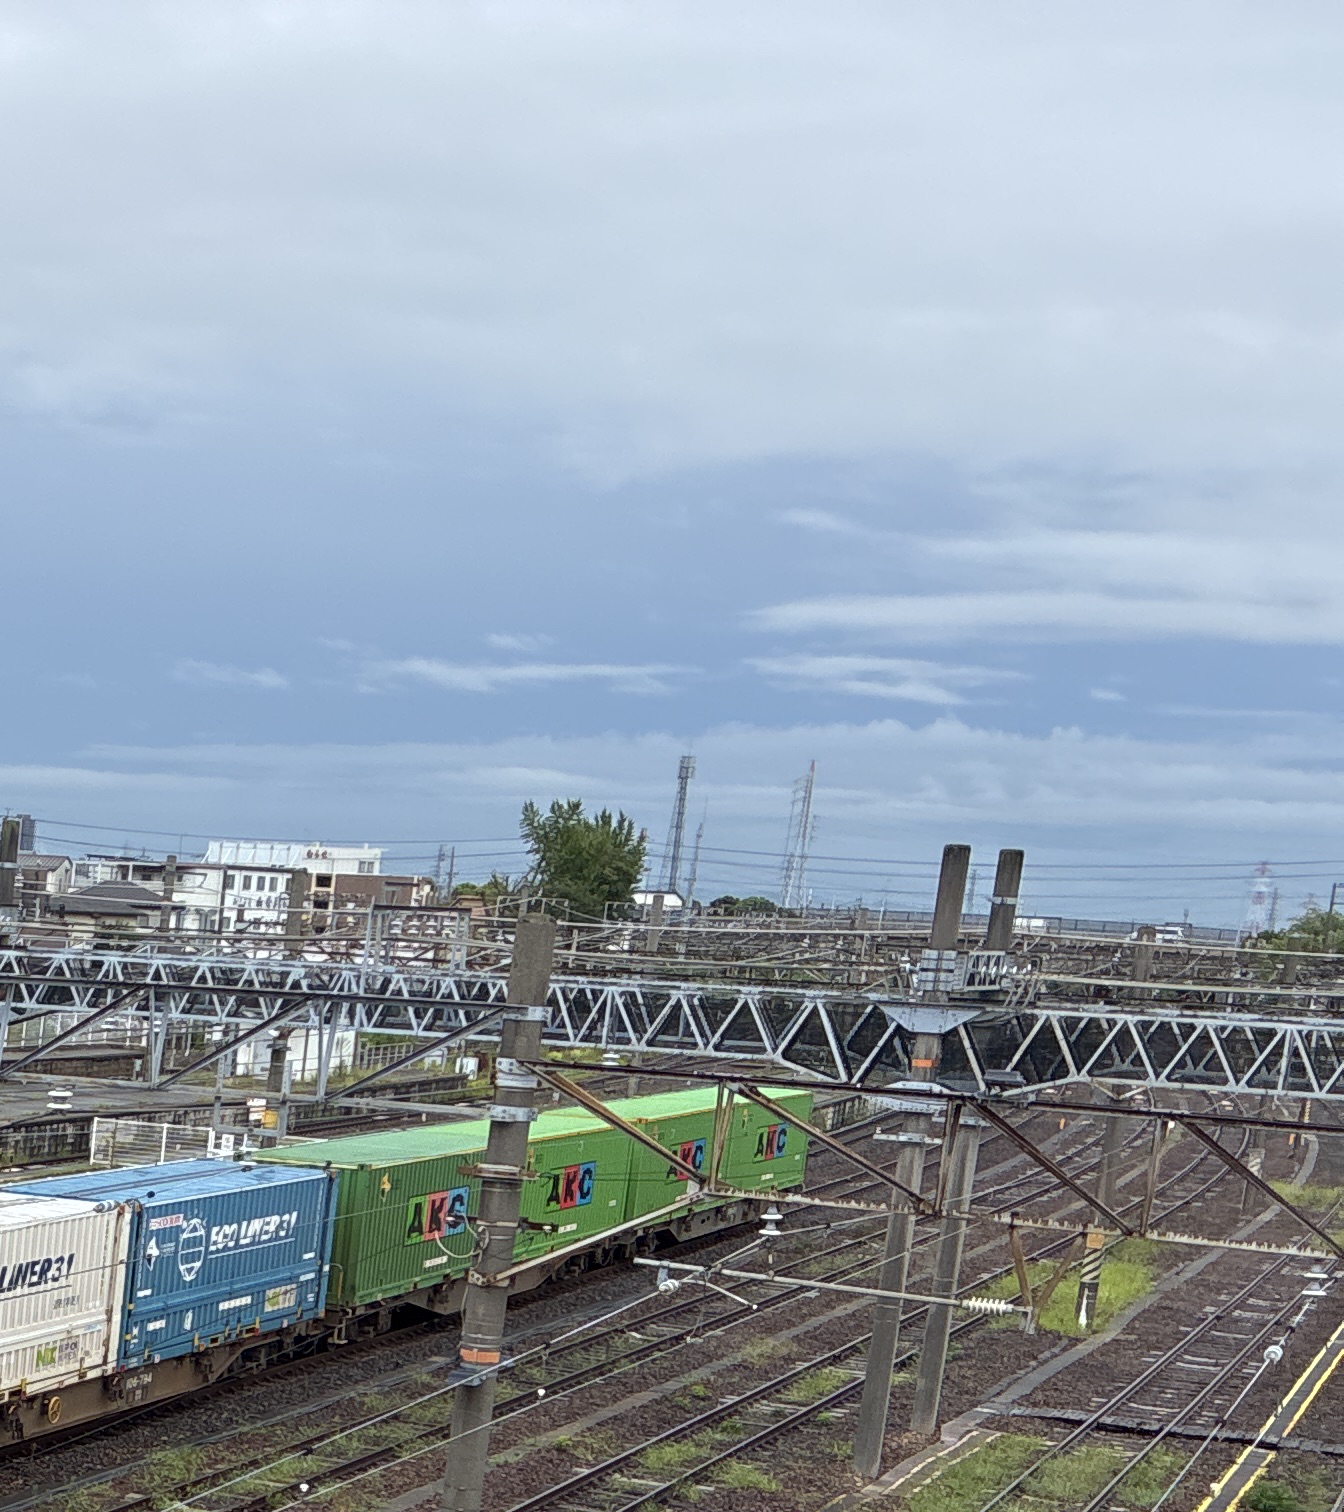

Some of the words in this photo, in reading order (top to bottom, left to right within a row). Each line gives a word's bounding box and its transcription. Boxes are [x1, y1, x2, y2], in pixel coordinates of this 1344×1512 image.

[546, 1168, 593, 1208] AKC
[209, 1222, 238, 1251] ECO
[279, 1211, 298, 1237] 31
[407, 1193, 465, 1240] AKC
[52, 1253, 75, 1283] 31
